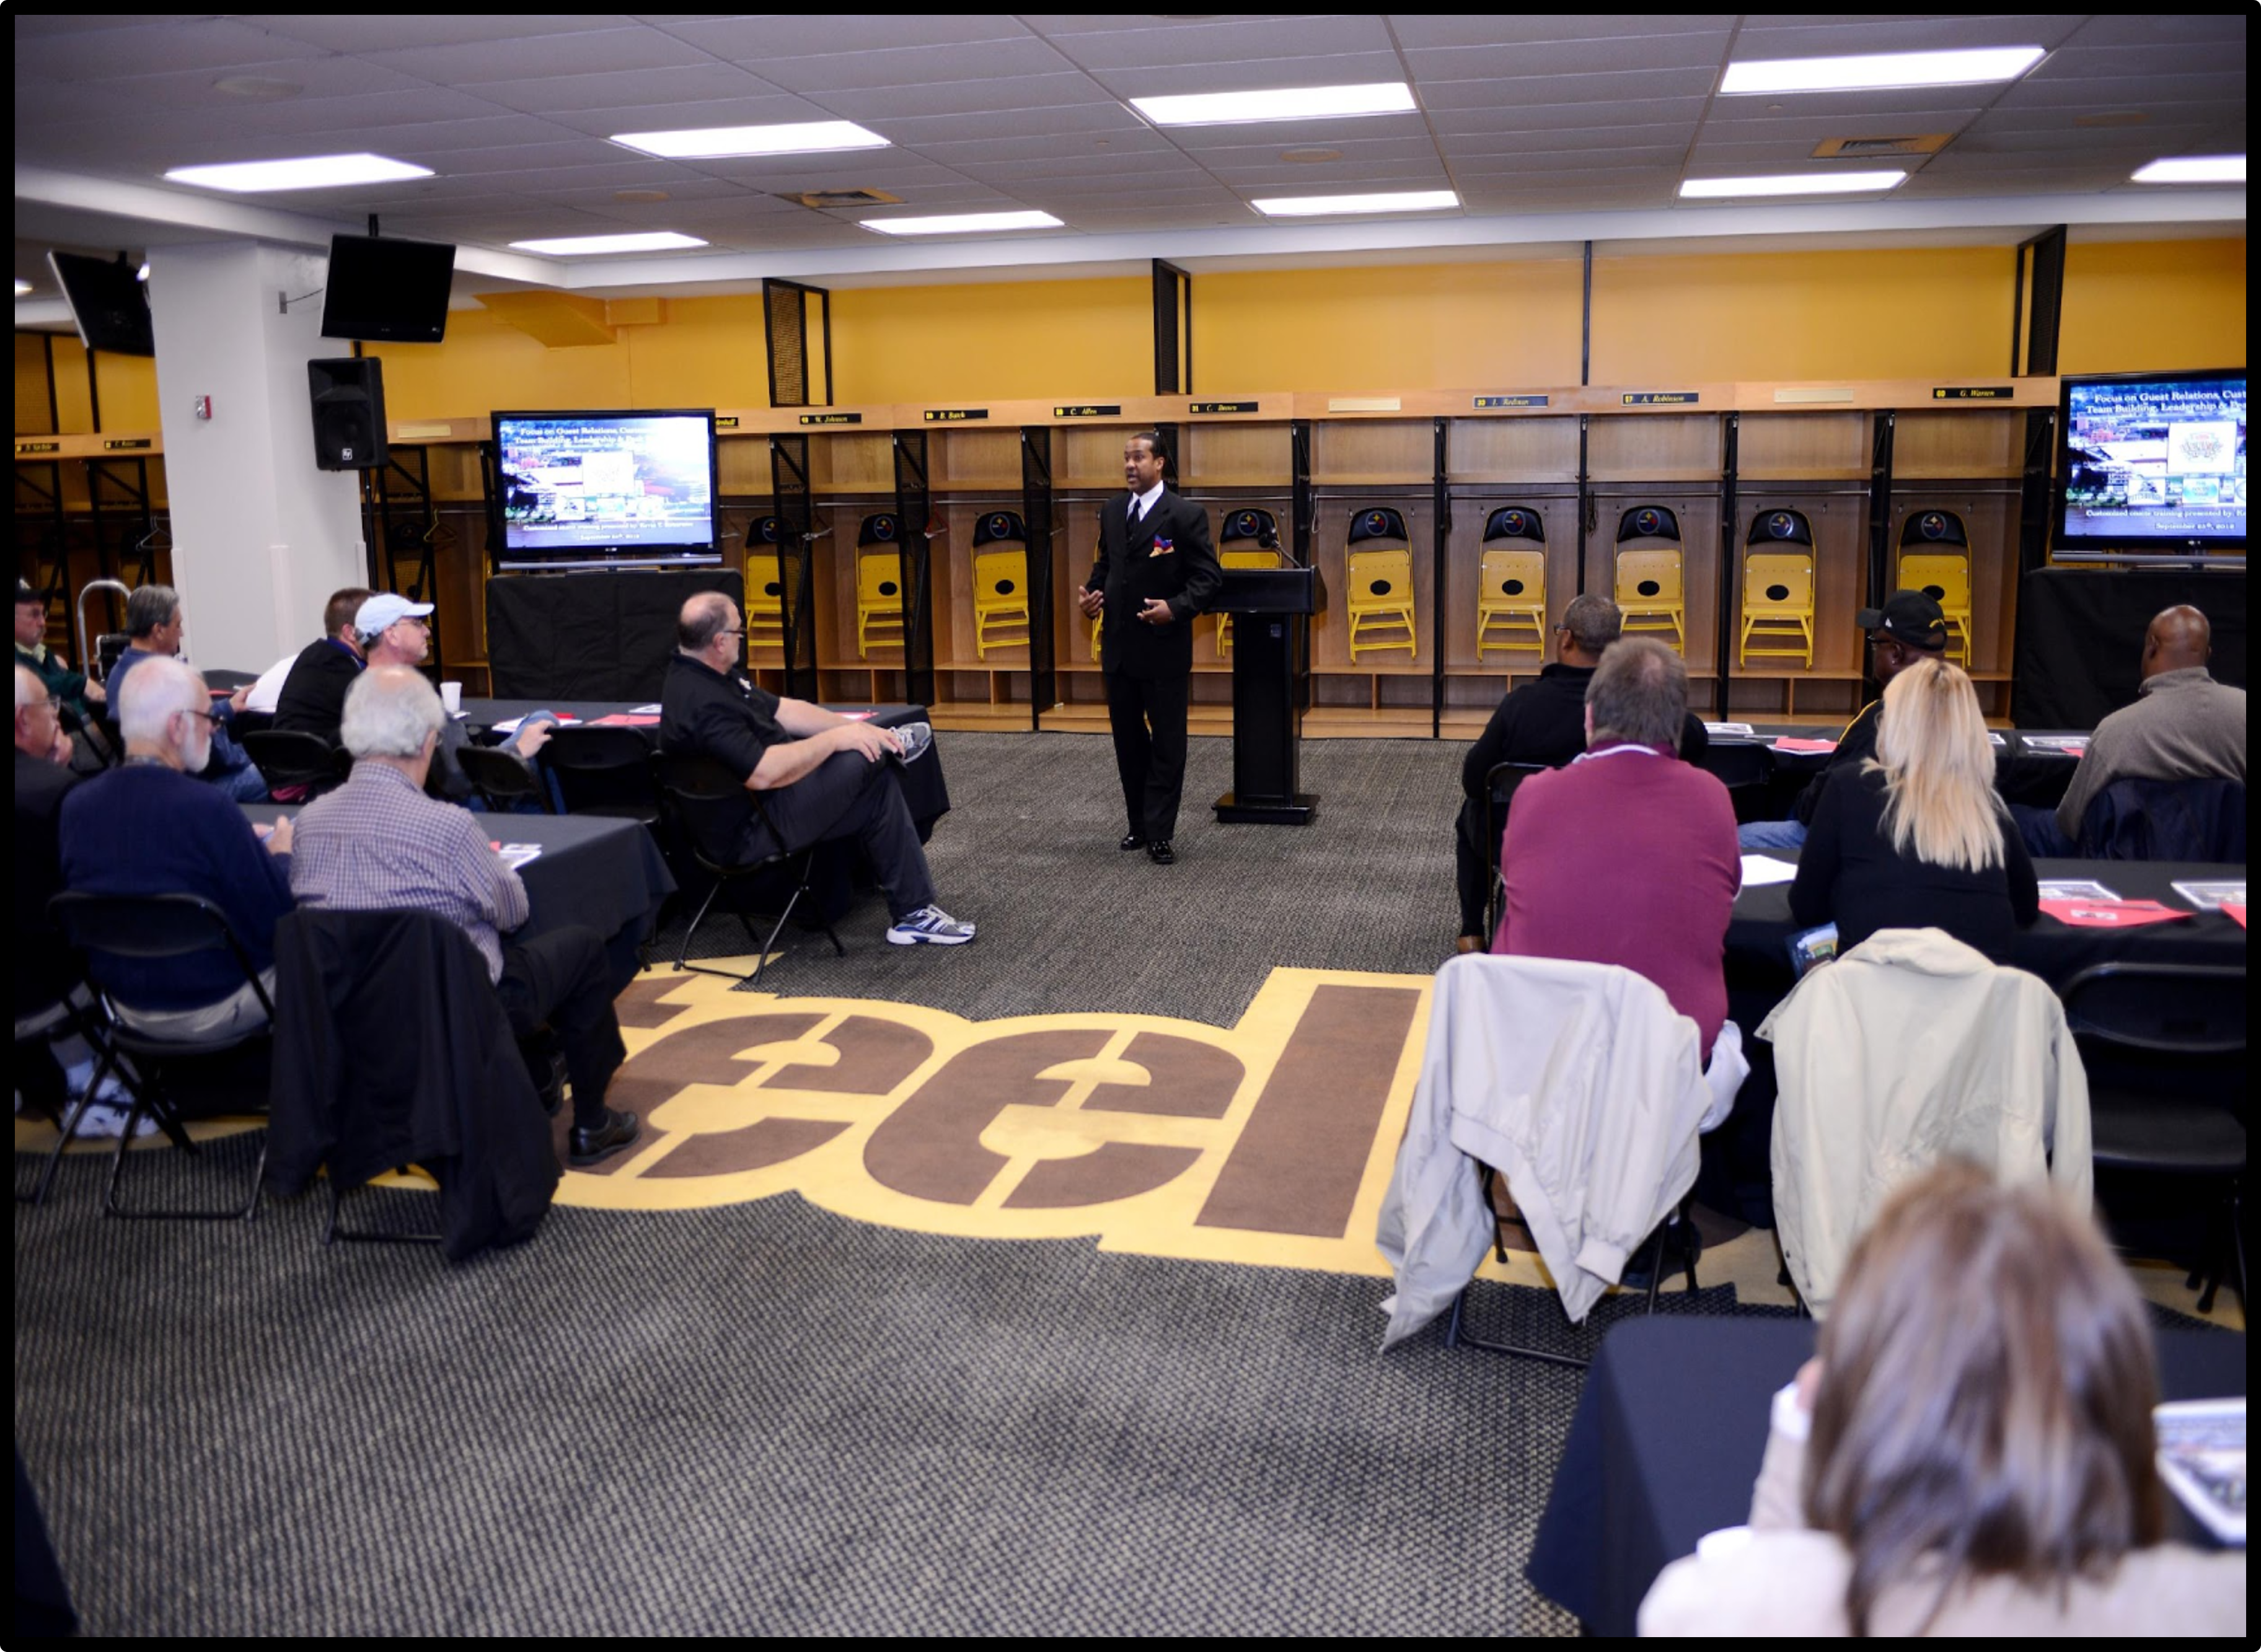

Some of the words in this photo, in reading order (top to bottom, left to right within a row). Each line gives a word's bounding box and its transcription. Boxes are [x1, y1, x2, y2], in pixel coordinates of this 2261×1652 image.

[2095, 394, 2122, 403] Focus
[2139, 393, 2169, 402] Guest
[2171, 390, 2220, 401] Relations,
[2086, 405, 2112, 414] Team
[2115, 403, 2158, 416] Building,
[2161, 400, 2216, 412] Leadership
